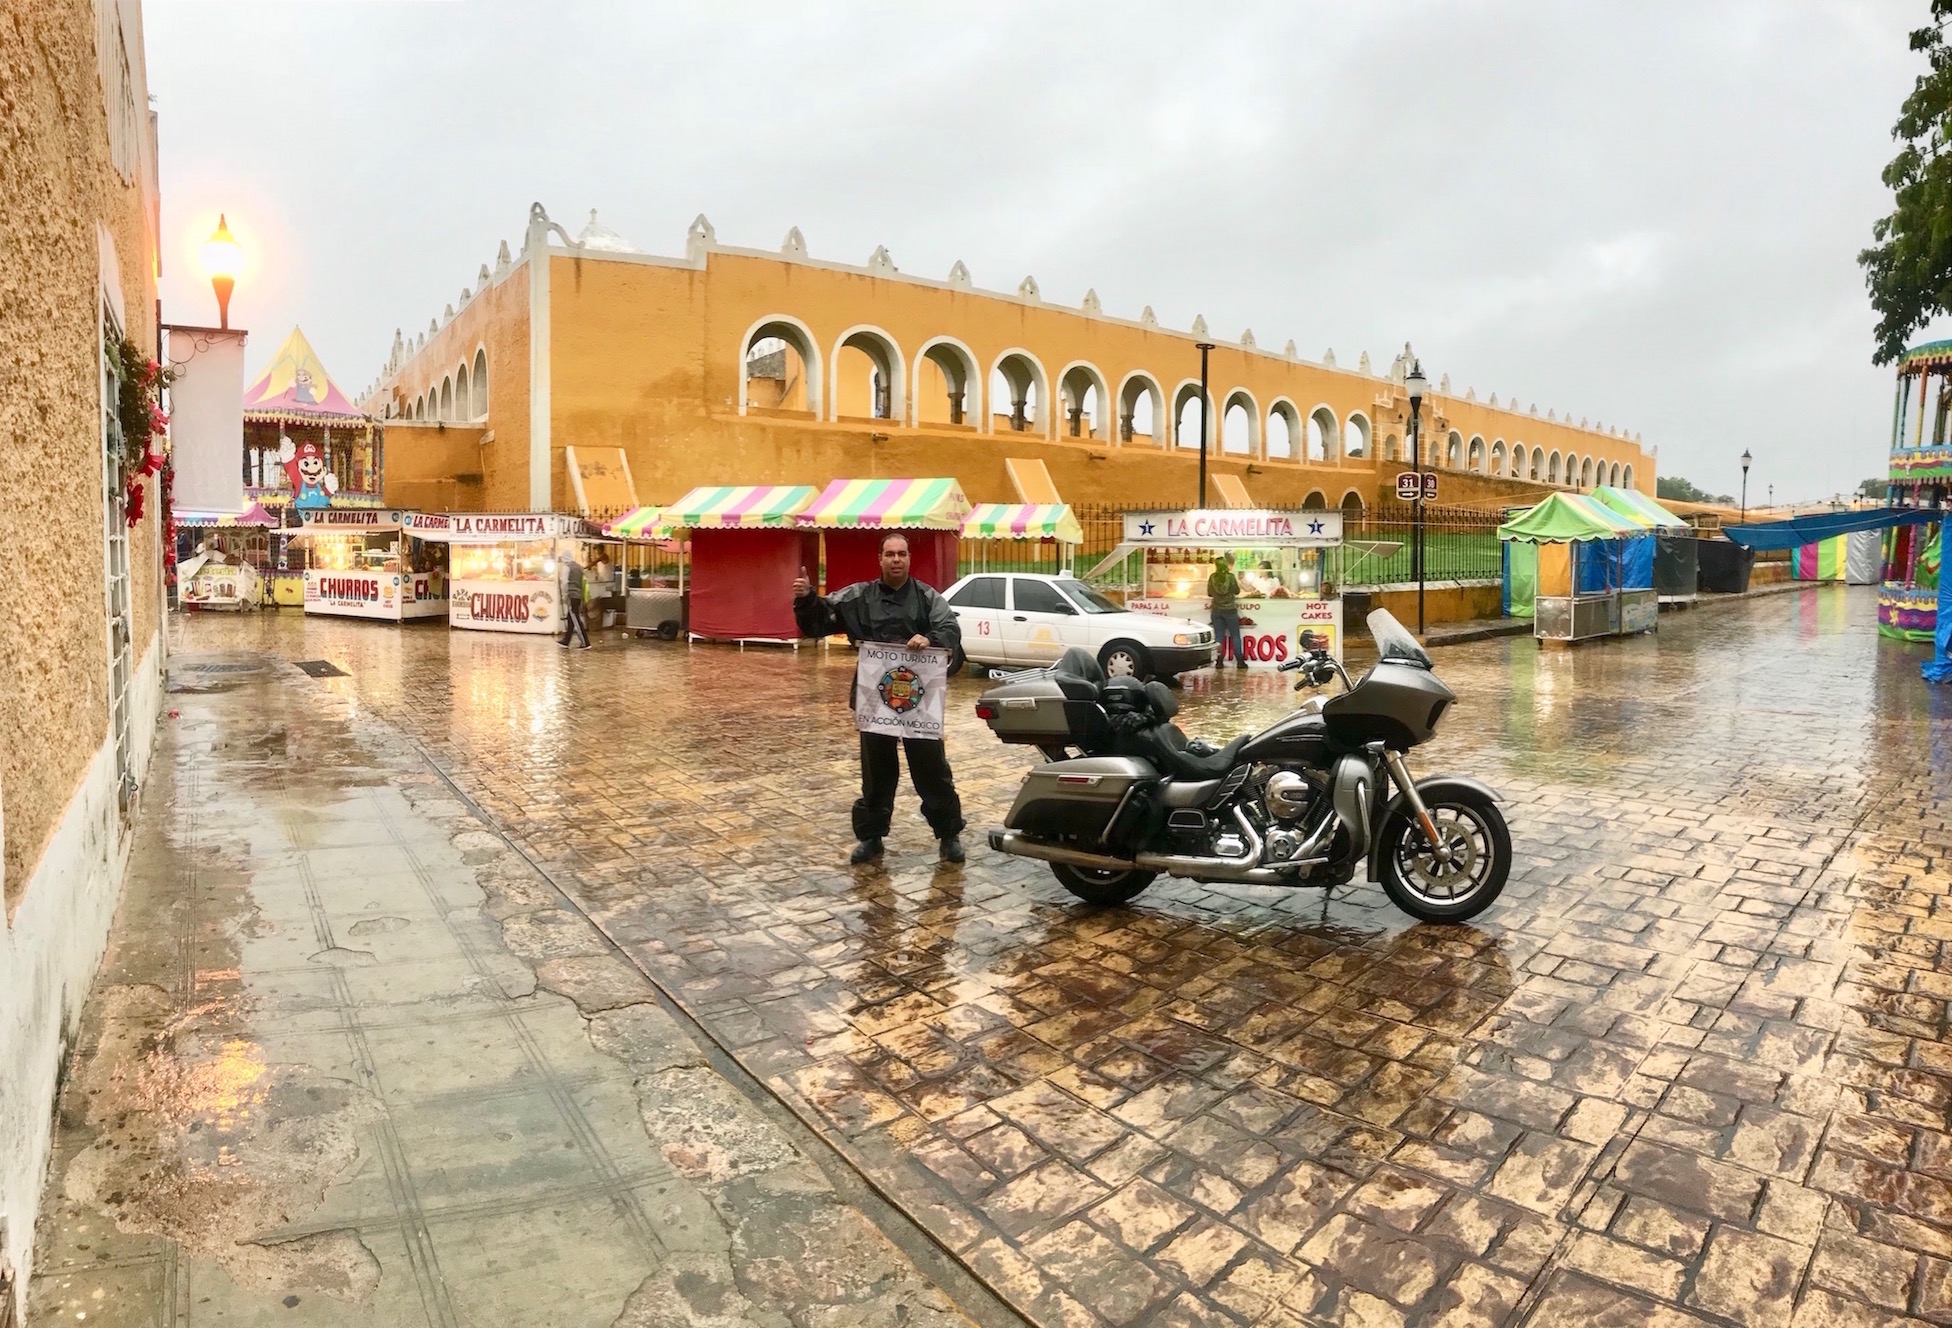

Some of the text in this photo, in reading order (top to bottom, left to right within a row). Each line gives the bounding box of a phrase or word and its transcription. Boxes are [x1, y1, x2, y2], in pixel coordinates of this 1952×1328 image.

[1402, 478, 1414, 488] 31
[314, 511, 378, 525] LA CARMELITA
[413, 515, 423, 528] LA
[1167, 517, 1293, 537] LA CARMELITA
[320, 577, 379, 601] CHURROS
[471, 592, 529, 623] CHURROS
[1131, 602, 1152, 610] PAPAS
[1306, 602, 1329, 611] HOT
[1301, 611, 1333, 620] CAKES
[977, 620, 991, 636] 13
[867, 649, 938, 664] MOTO TURISTA
[858, 715, 940, 730] EN ACCIÓN MÉXICO
